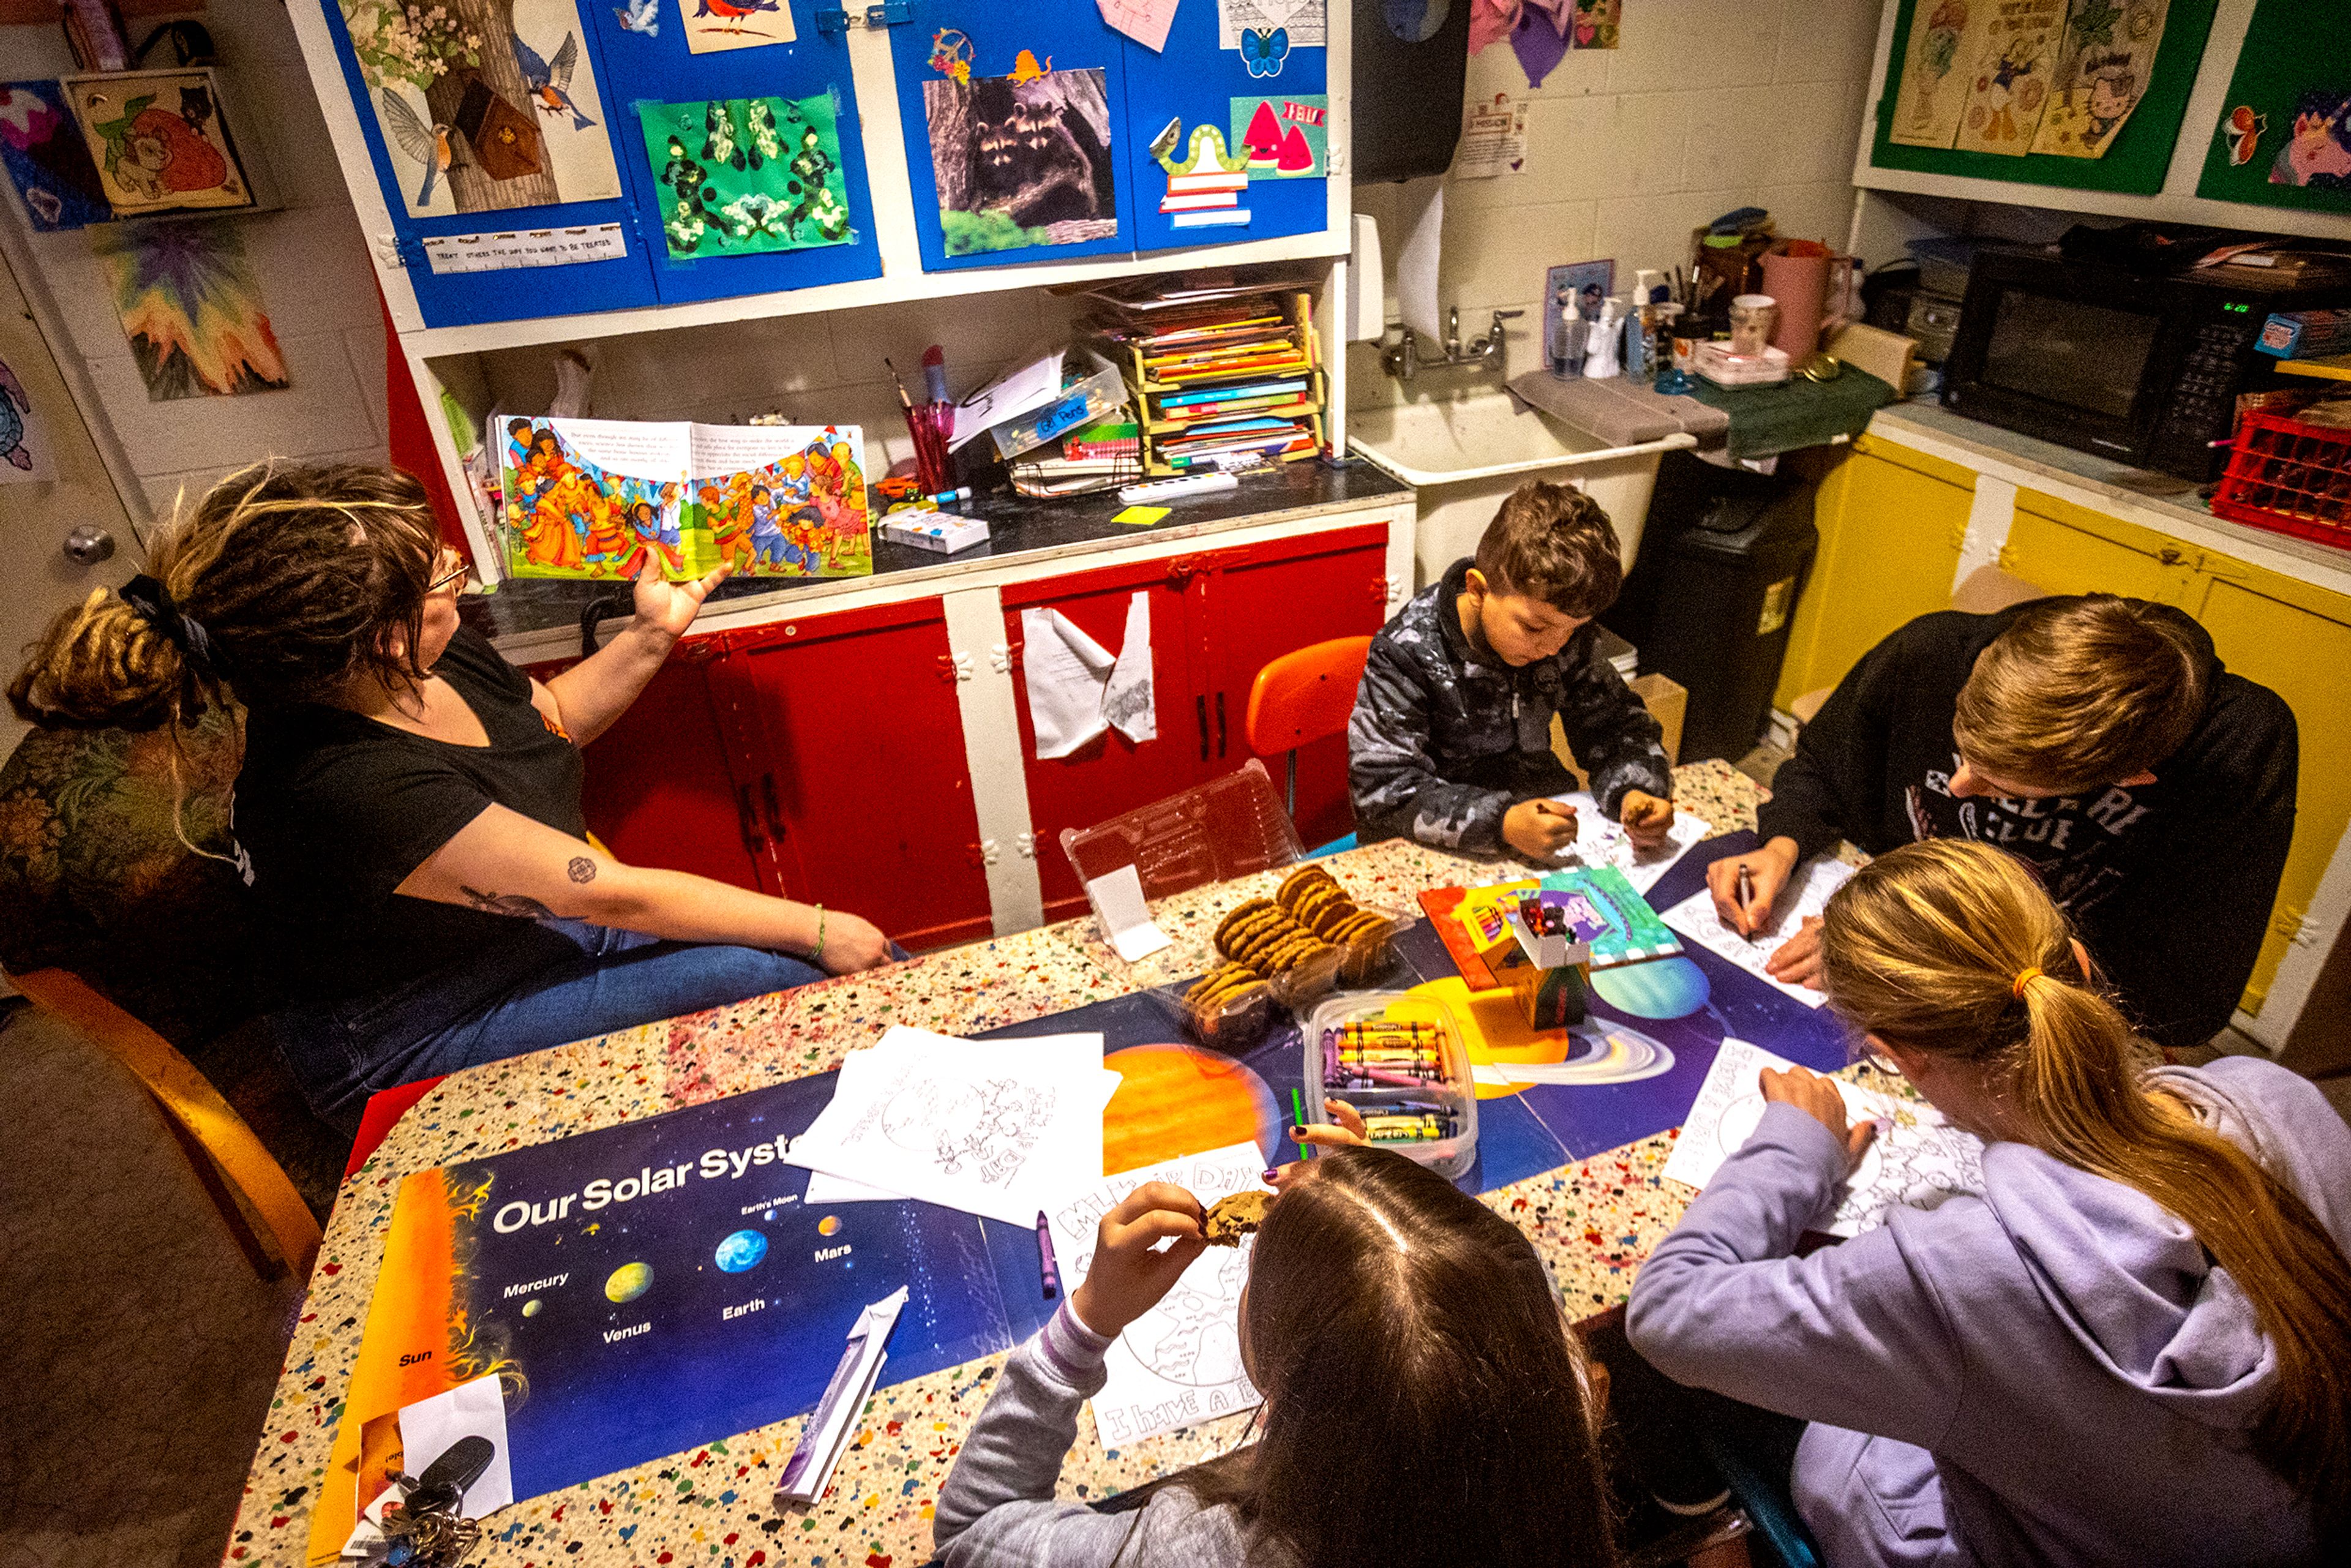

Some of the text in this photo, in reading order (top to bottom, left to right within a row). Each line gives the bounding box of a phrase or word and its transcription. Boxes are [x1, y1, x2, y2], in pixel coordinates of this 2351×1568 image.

[1058, 405, 1084, 422] Pens
[1194, 1161, 1260, 1192] DAY
[493, 1191, 577, 1234] Our
[582, 1160, 693, 1210] Solar
[741, 1193, 798, 1215] Earth's Moon
[814, 1242, 852, 1263] Mars
[503, 1271, 569, 1299] Mercury
[722, 1297, 765, 1321] Earth
[603, 1320, 651, 1344] Venus
[399, 1349, 432, 1368] Sun
[1105, 1408, 1131, 1441] I
[1209, 1389, 1229, 1412] A
